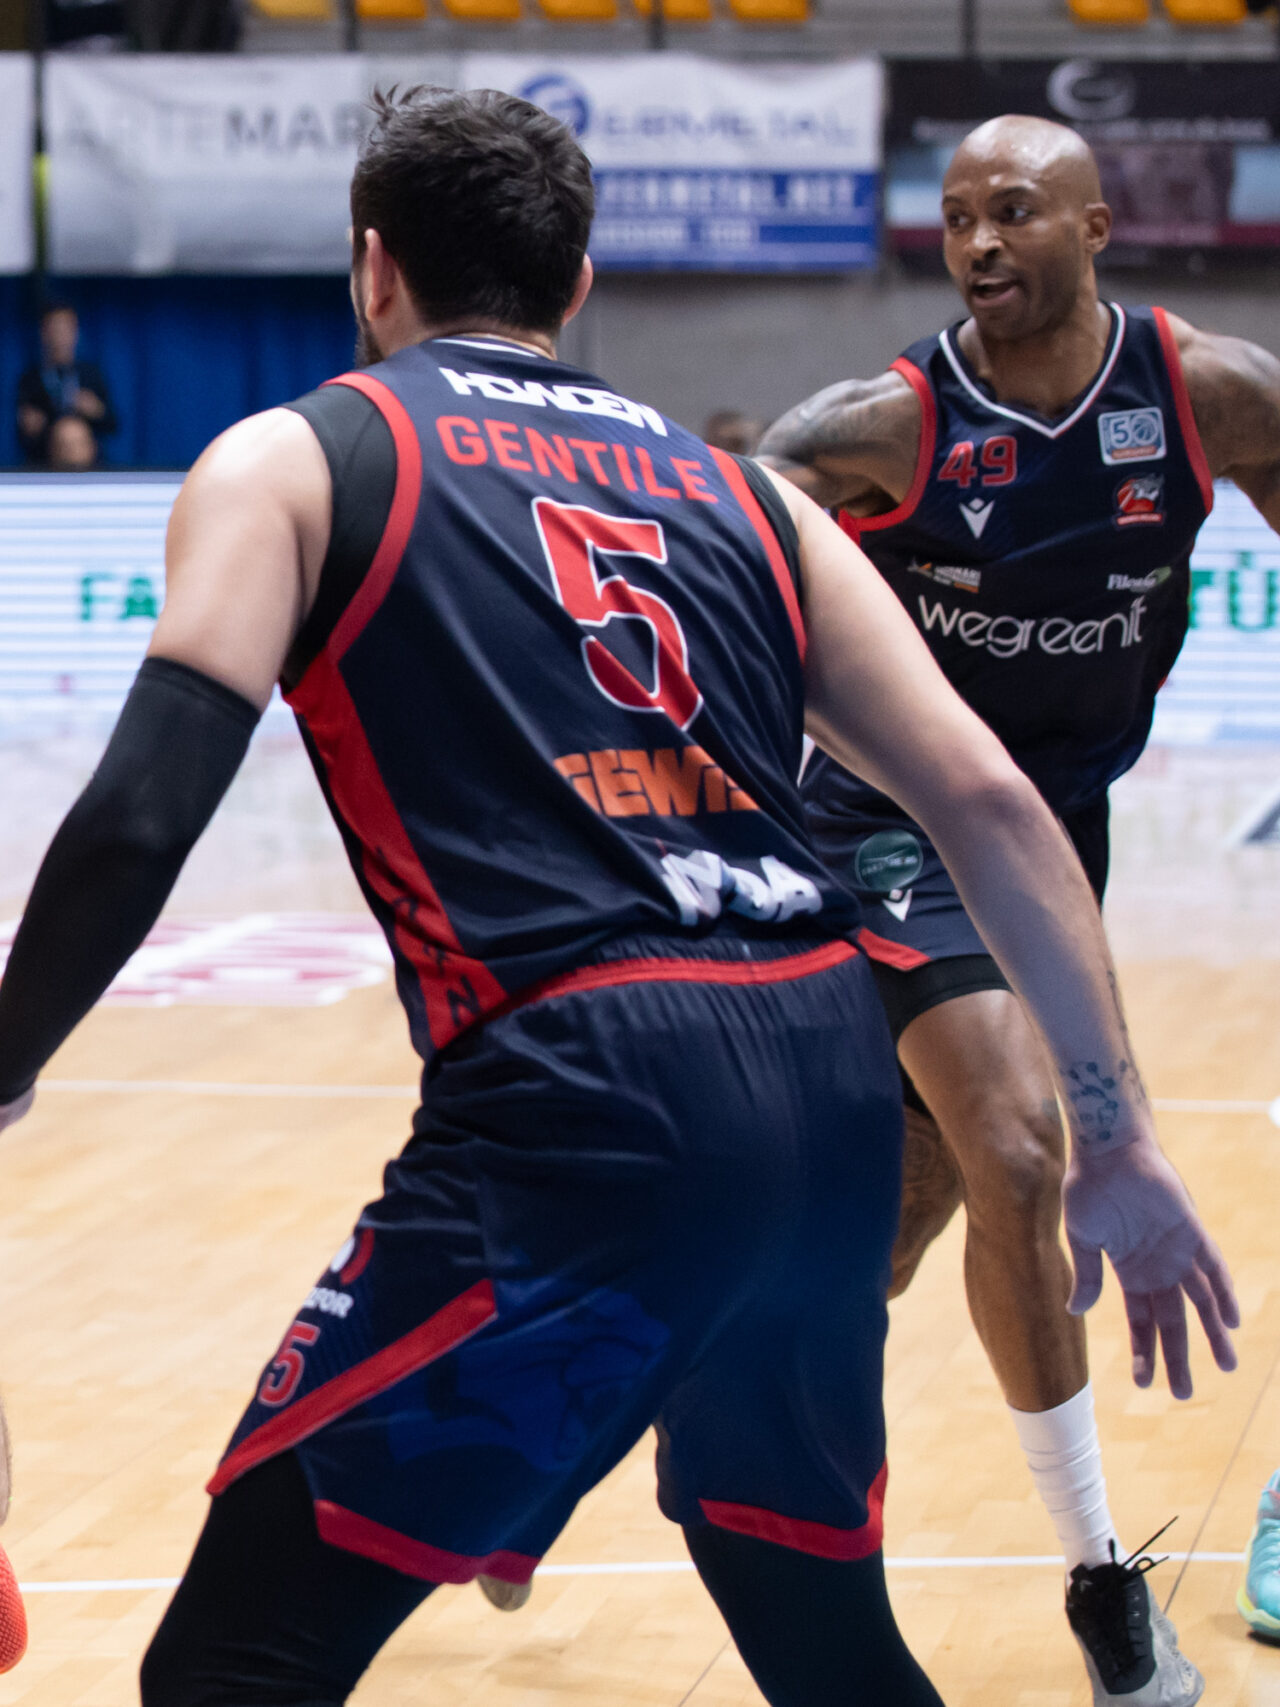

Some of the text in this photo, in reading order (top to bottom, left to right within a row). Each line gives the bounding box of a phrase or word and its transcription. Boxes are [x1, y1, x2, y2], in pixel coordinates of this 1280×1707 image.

[438, 367, 668, 437] HOWDEN
[435, 415, 719, 504] GENTILE
[937, 435, 1018, 488] 49
[530, 496, 704, 732] 5
[257, 1320, 321, 1407] 5
